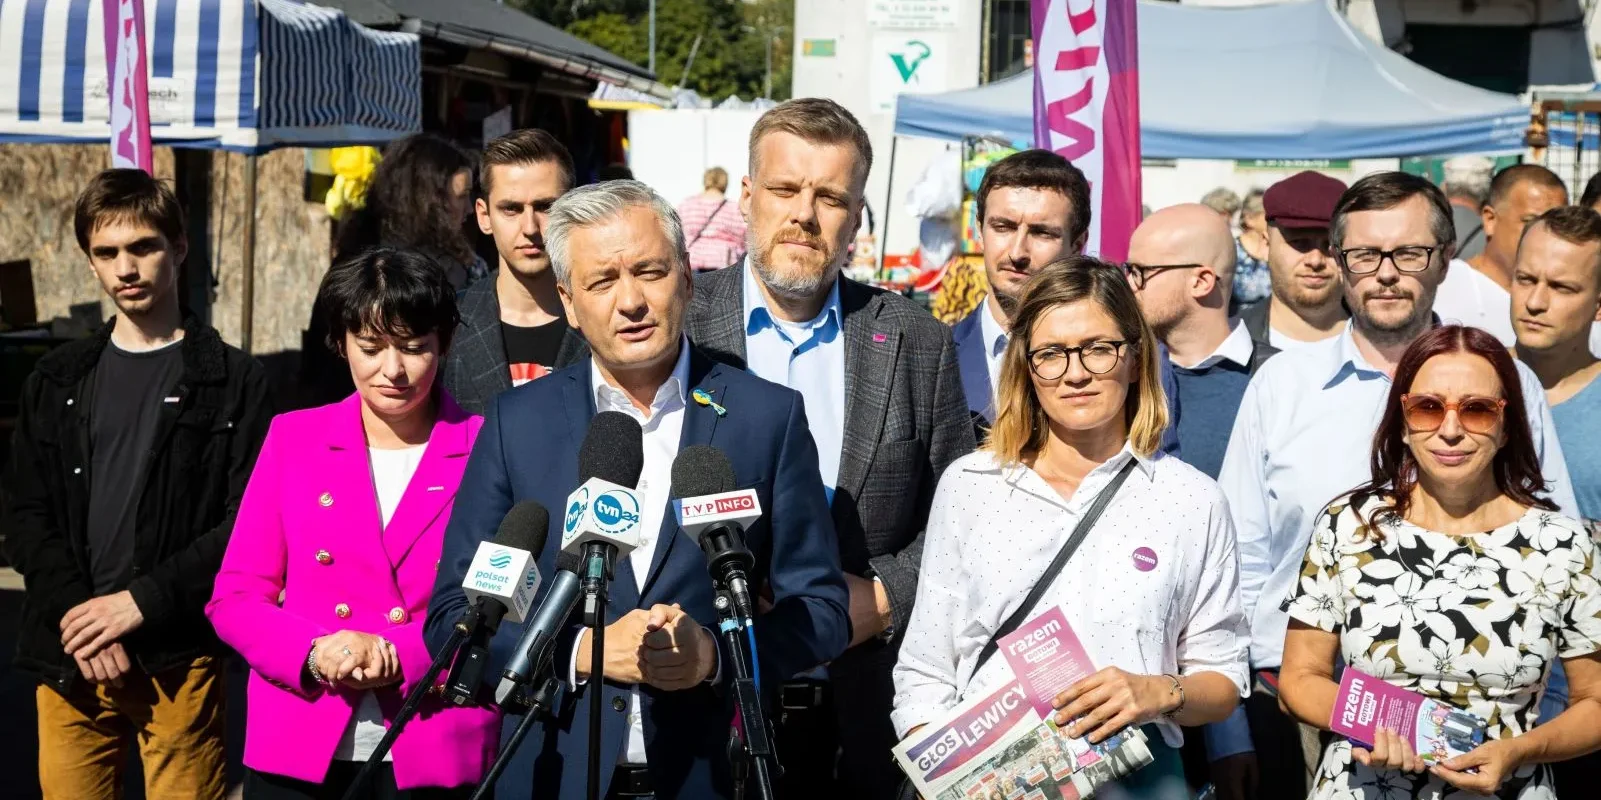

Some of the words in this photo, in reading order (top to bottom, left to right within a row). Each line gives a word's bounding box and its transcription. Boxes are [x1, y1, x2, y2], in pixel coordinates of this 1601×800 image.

[682, 503, 714, 516] TVP
[717, 497, 753, 511] INFO
[1133, 553, 1156, 565] razem
[475, 570, 510, 584] polsat
[475, 580, 503, 592] news
[1008, 619, 1062, 656] razem
[1341, 677, 1365, 729] razem
[918, 734, 957, 772] GŁOS
[960, 683, 1027, 748] LEWICY
